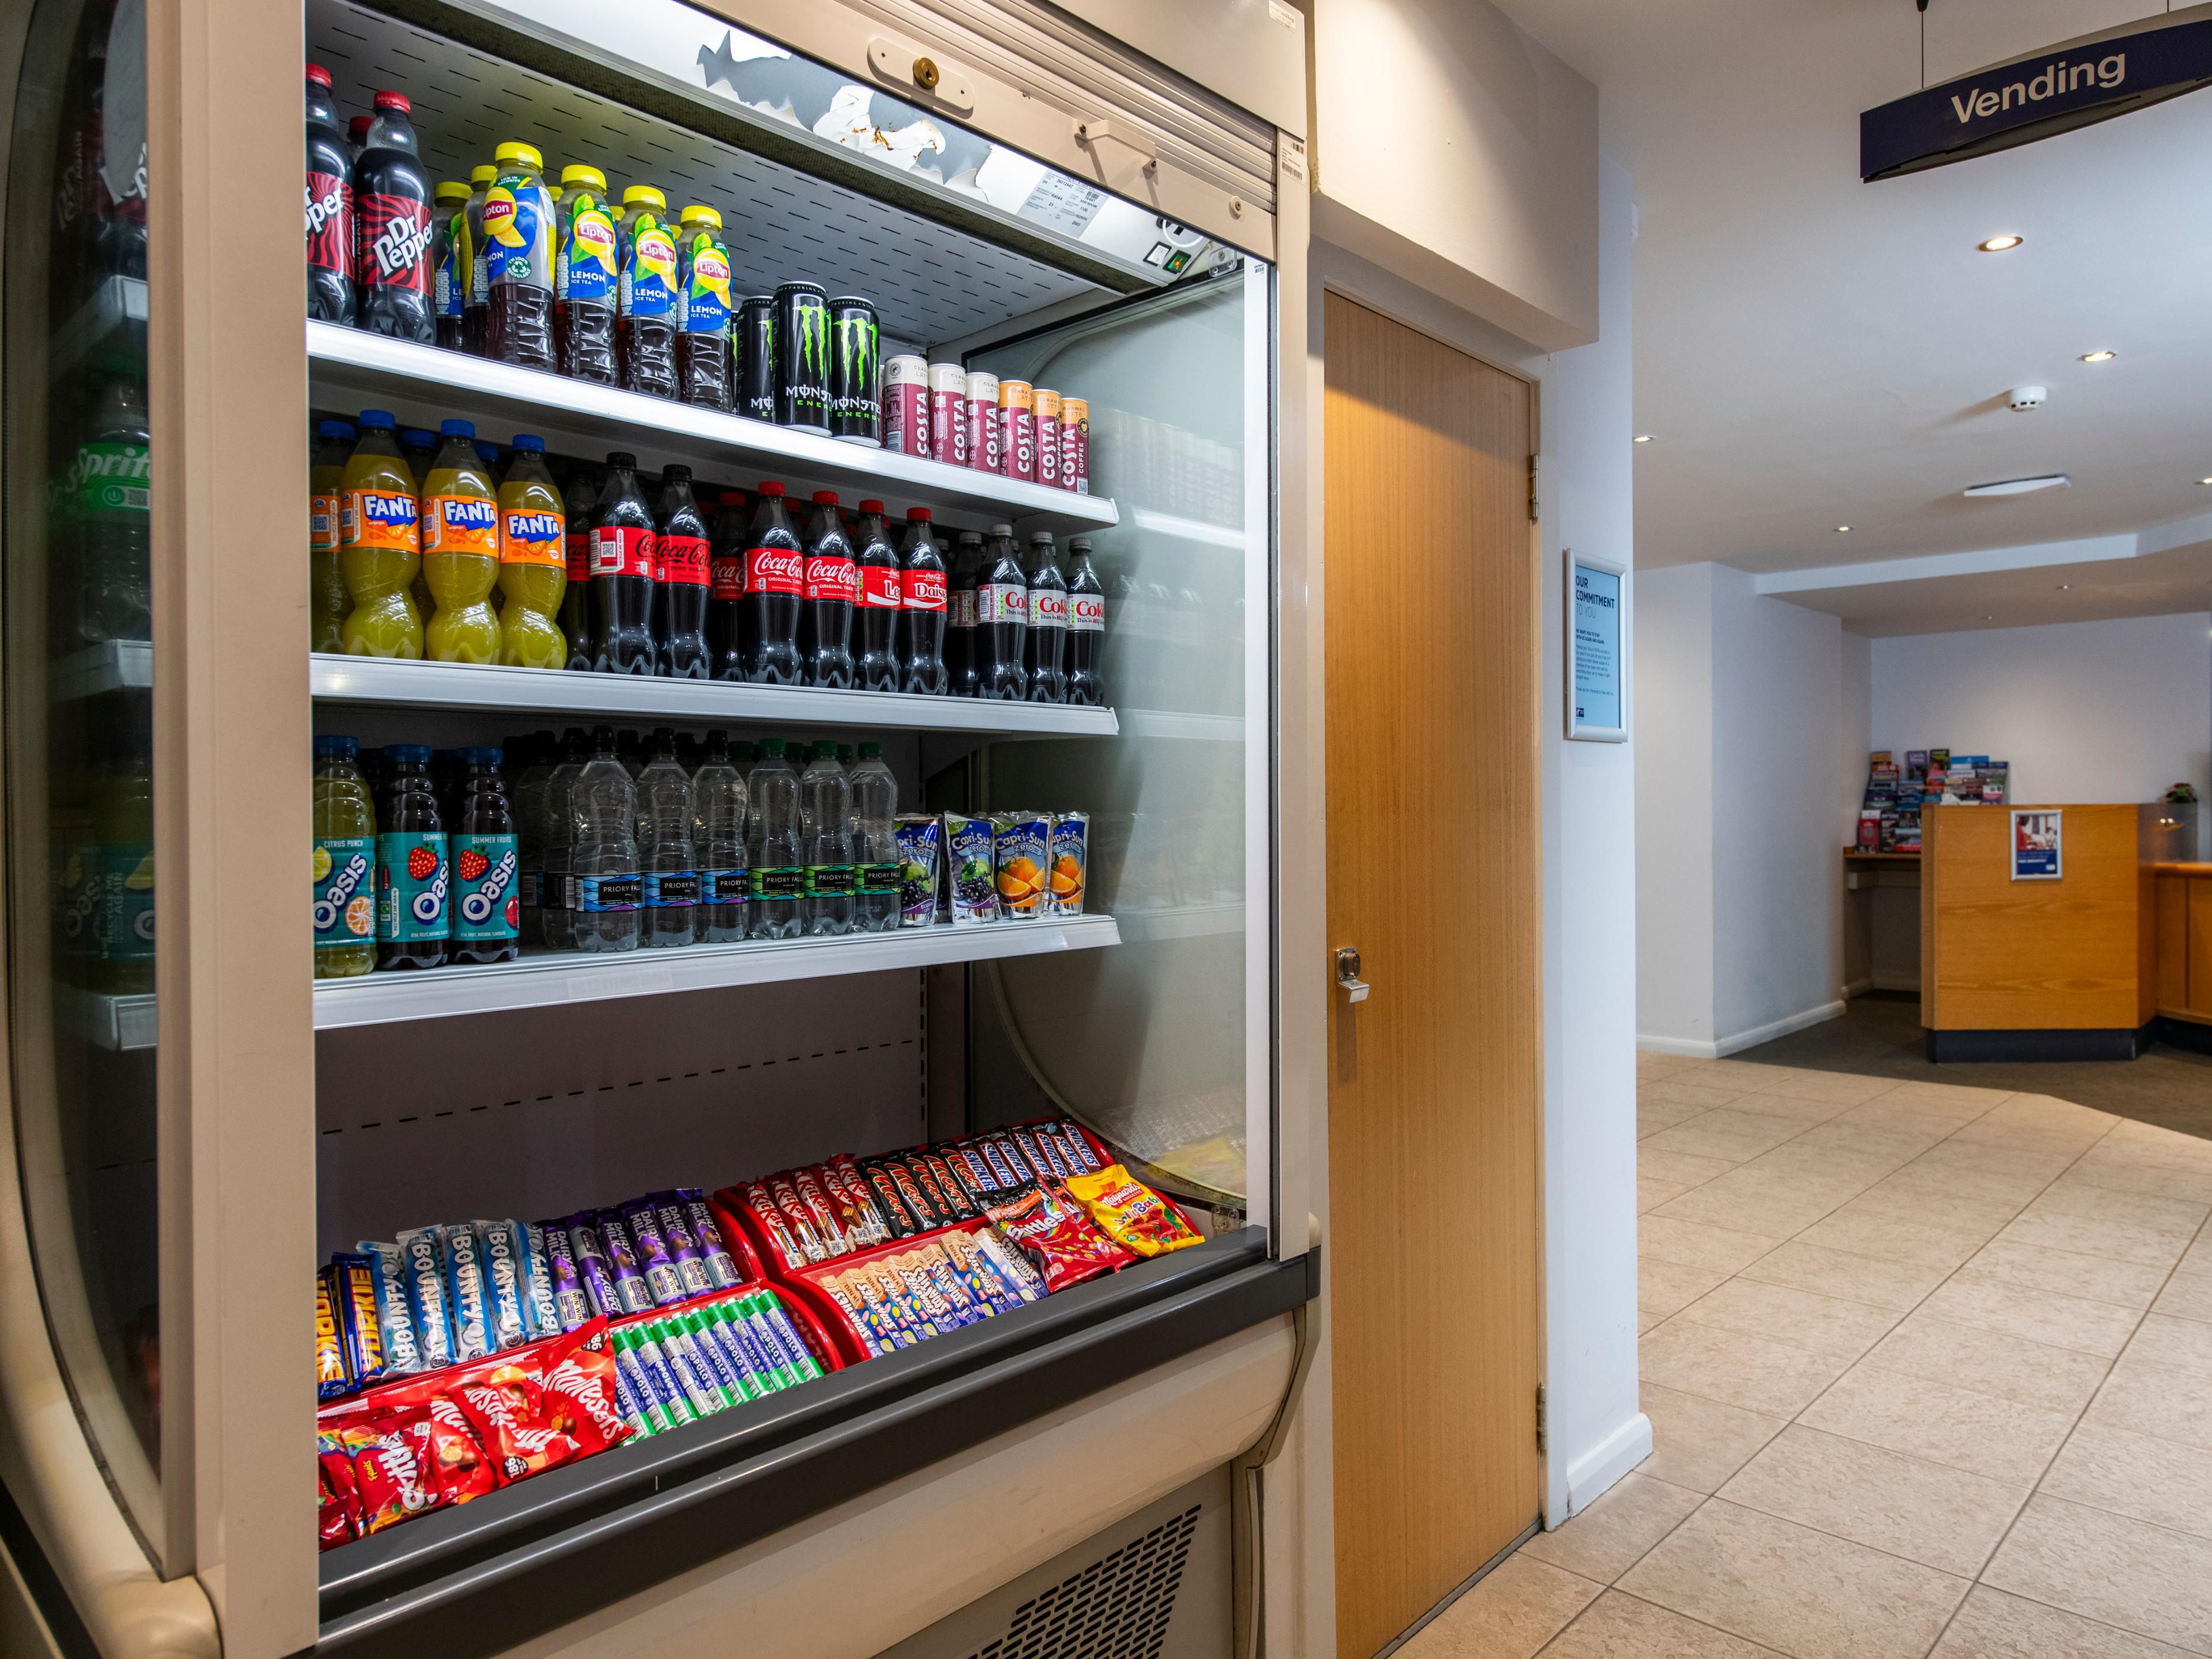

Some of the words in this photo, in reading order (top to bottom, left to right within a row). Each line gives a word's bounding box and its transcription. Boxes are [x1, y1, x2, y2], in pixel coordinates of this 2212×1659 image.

[1951, 53, 2125, 124] Vending
[386, 215, 417, 246] Dr
[580, 226, 613, 242] Lipton
[373, 220, 433, 277] Pepper
[643, 244, 674, 260] Lipton
[507, 266, 532, 278] RECYCLABLE
[571, 271, 606, 283] LEMON
[700, 262, 728, 276] Lipton
[635, 288, 668, 300] LEMON
[691, 305, 722, 316] LEMON
[916, 393, 929, 454] COSTA
[954, 400, 966, 461] COSTA
[986, 408, 998, 467] COSTA
[1017, 414, 1030, 473] COSTA
[1042, 421, 1057, 479] COSTA
[1062, 429, 1077, 486] COSTA
[78, 447, 150, 484] Sprit
[364, 496, 417, 518] FANTA
[444, 501, 495, 522] FANTA
[508, 514, 560, 534] FANTA
[914, 583, 947, 603] Daisy
[1576, 575, 1588, 588] OUR
[1076, 601, 1105, 617] Coke
[1576, 589, 1615, 609] COMMITMENT
[1576, 603, 1583, 616] TO
[1584, 605, 1596, 619] YOU
[995, 832, 1046, 850] Capri-Sun
[313, 853, 367, 928] Oasis
[462, 849, 516, 920] Oasis
[1017, 1134, 1053, 1176] SNICKERS
[1038, 1134, 1069, 1178] SNICKERS
[1066, 1126, 1100, 1165] SNICKERS
[963, 1151, 1000, 1192] SNICKERS
[981, 1144, 1018, 1187] SNICKERS
[797, 1180, 830, 1213] KitKat
[839, 1167, 870, 1198] KitKat
[883, 1162, 936, 1218] Mars
[906, 1157, 953, 1217] Mars
[923, 1155, 973, 1210] Mars
[1101, 1182, 1141, 1206] Maynards
[1123, 1190, 1142, 1201] BASSETTS
[750, 1193, 785, 1227] KitKat
[775, 1187, 806, 1219] KitKat
[867, 1167, 915, 1228] Mars
[630, 1213, 648, 1241] MILK
[640, 1210, 661, 1242] DAIRY
[658, 1208, 676, 1232] MILK
[668, 1206, 687, 1237] DAIRY
[689, 1202, 708, 1228] MILK
[697, 1202, 715, 1232] DAIRY
[827, 1213, 844, 1240] CHUNKY
[546, 1232, 558, 1261] MILK
[604, 1222, 622, 1248] MILK
[614, 1222, 633, 1254] DAIRY
[782, 1226, 798, 1253] CHUNKY
[556, 1231, 572, 1269] DAIRY
[948, 1243, 959, 1257] PAPER
[411, 1244, 445, 1326] BOUNTY
[452, 1235, 484, 1319] BOUNTY
[488, 1232, 519, 1313] BOUNTY
[663, 1267, 678, 1294] WIN-WIN
[693, 1260, 708, 1286] WIN-WIN
[866, 1276, 876, 1289] PAPER
[886, 1269, 897, 1282] PAPER
[932, 1261, 970, 1308] SMARTIES
[530, 1253, 559, 1330] BOUNTY
[844, 1283, 854, 1296] PAPER
[878, 1276, 919, 1322] SMARTIES
[916, 1267, 952, 1315] SMARTIES
[349, 1268, 383, 1373] YORKIE
[383, 1277, 418, 1358] BOUNTY
[571, 1292, 583, 1321] WIN-WIN
[856, 1283, 898, 1330] SMARTIES
[728, 1344, 744, 1367] POLO
[746, 1344, 760, 1366] POLO
[764, 1336, 780, 1357] POLO
[782, 1331, 798, 1353] POLO
[658, 1366, 675, 1389] POLO
[693, 1358, 709, 1381] POLO
[711, 1352, 726, 1375] POLO
[543, 1358, 624, 1440] Maltesers
[616, 1379, 630, 1405] POLO
[634, 1374, 650, 1398] POLO
